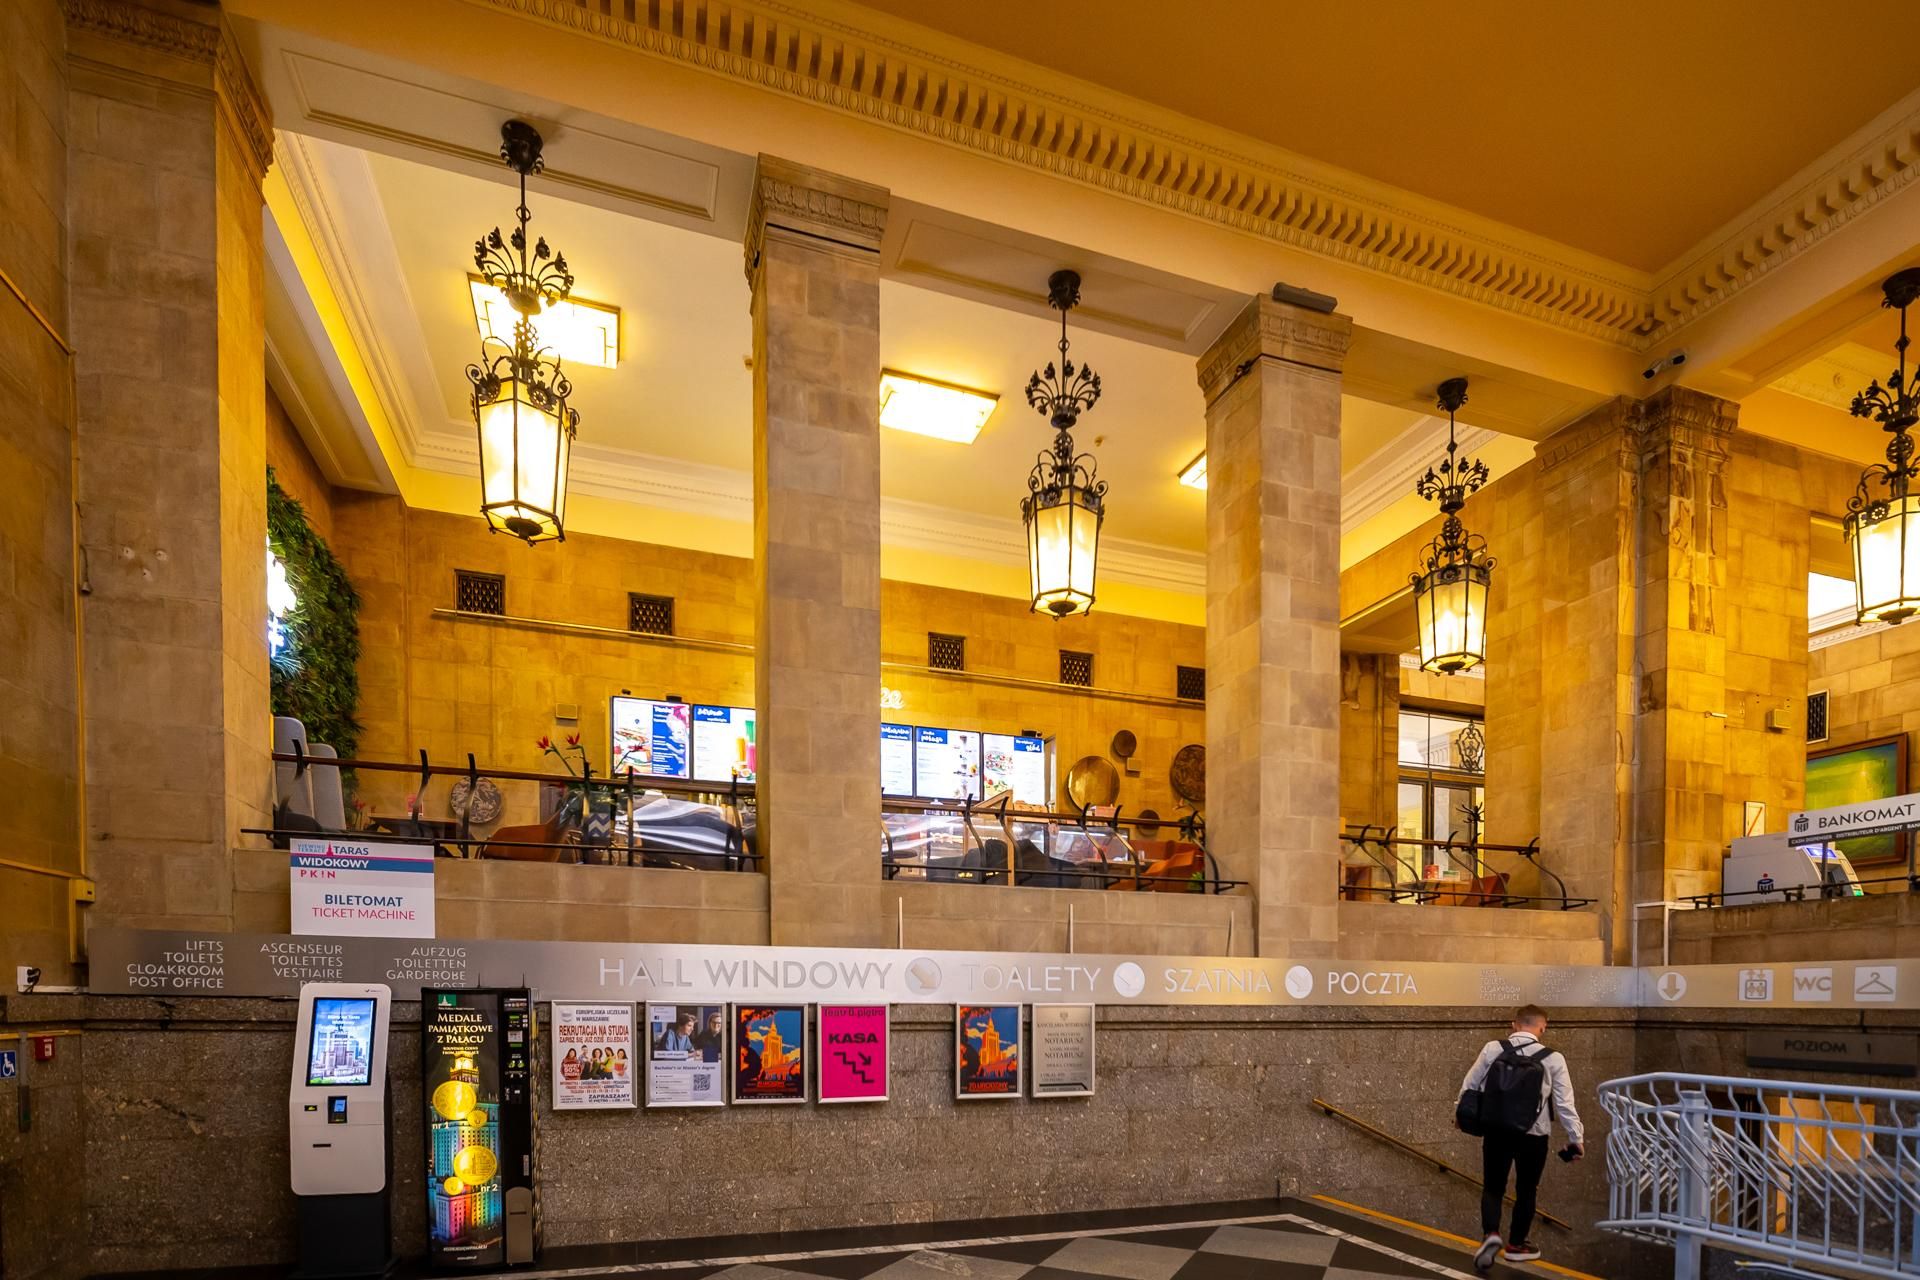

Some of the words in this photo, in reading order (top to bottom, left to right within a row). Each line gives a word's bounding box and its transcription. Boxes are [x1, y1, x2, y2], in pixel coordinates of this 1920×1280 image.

[1818, 803, 1916, 829] BANKOMAT
[1836, 829, 1873, 839] DISTRIBUTEUR
[1874, 824, 1903, 834] D'ARGENT
[333, 845, 369, 855] TARAS
[298, 856, 369, 869] WIDOKOWY
[324, 894, 404, 907] BILETOMAT
[312, 907, 355, 919] TICKET
[357, 909, 416, 921] MACHINE
[185, 940, 224, 952] LIFTS
[260, 942, 343, 955] ASCENSEUR
[411, 947, 467, 957] AUFZUG
[163, 951, 224, 964] TOILETS
[269, 955, 343, 967] TOILETTES
[394, 958, 467, 969] TOILETTEN
[126, 963, 224, 977] CLOAKROOM
[273, 967, 343, 979] VESTIAIRE
[386, 969, 467, 981] GARDEROBE
[599, 958, 693, 988] HALL
[703, 958, 894, 990] WINDOWY
[129, 976, 171, 988] POST
[172, 977, 224, 989] OFFICE
[960, 963, 1102, 993] TOALETY
[1163, 967, 1273, 994] SZATNIA
[1327, 970, 1419, 995] POCZTA
[1794, 976, 1832, 992] WC
[437, 1013, 483, 1022] MEDALE
[428, 1024, 493, 1035] PAMIĄTKOWE
[559, 1024, 597, 1036] REKRUTACJA
[598, 1025, 607, 1036] NA
[607, 1025, 629, 1036] STUDIA
[446, 1034, 484, 1043] PAŁACU
[828, 1032, 879, 1044] KASA
[1784, 1039, 1847, 1054] POZIOM
[1044, 1051, 1084, 1059] NOTARIUSZ
[481, 1185, 491, 1193] nr
[492, 1184, 498, 1192] 2
